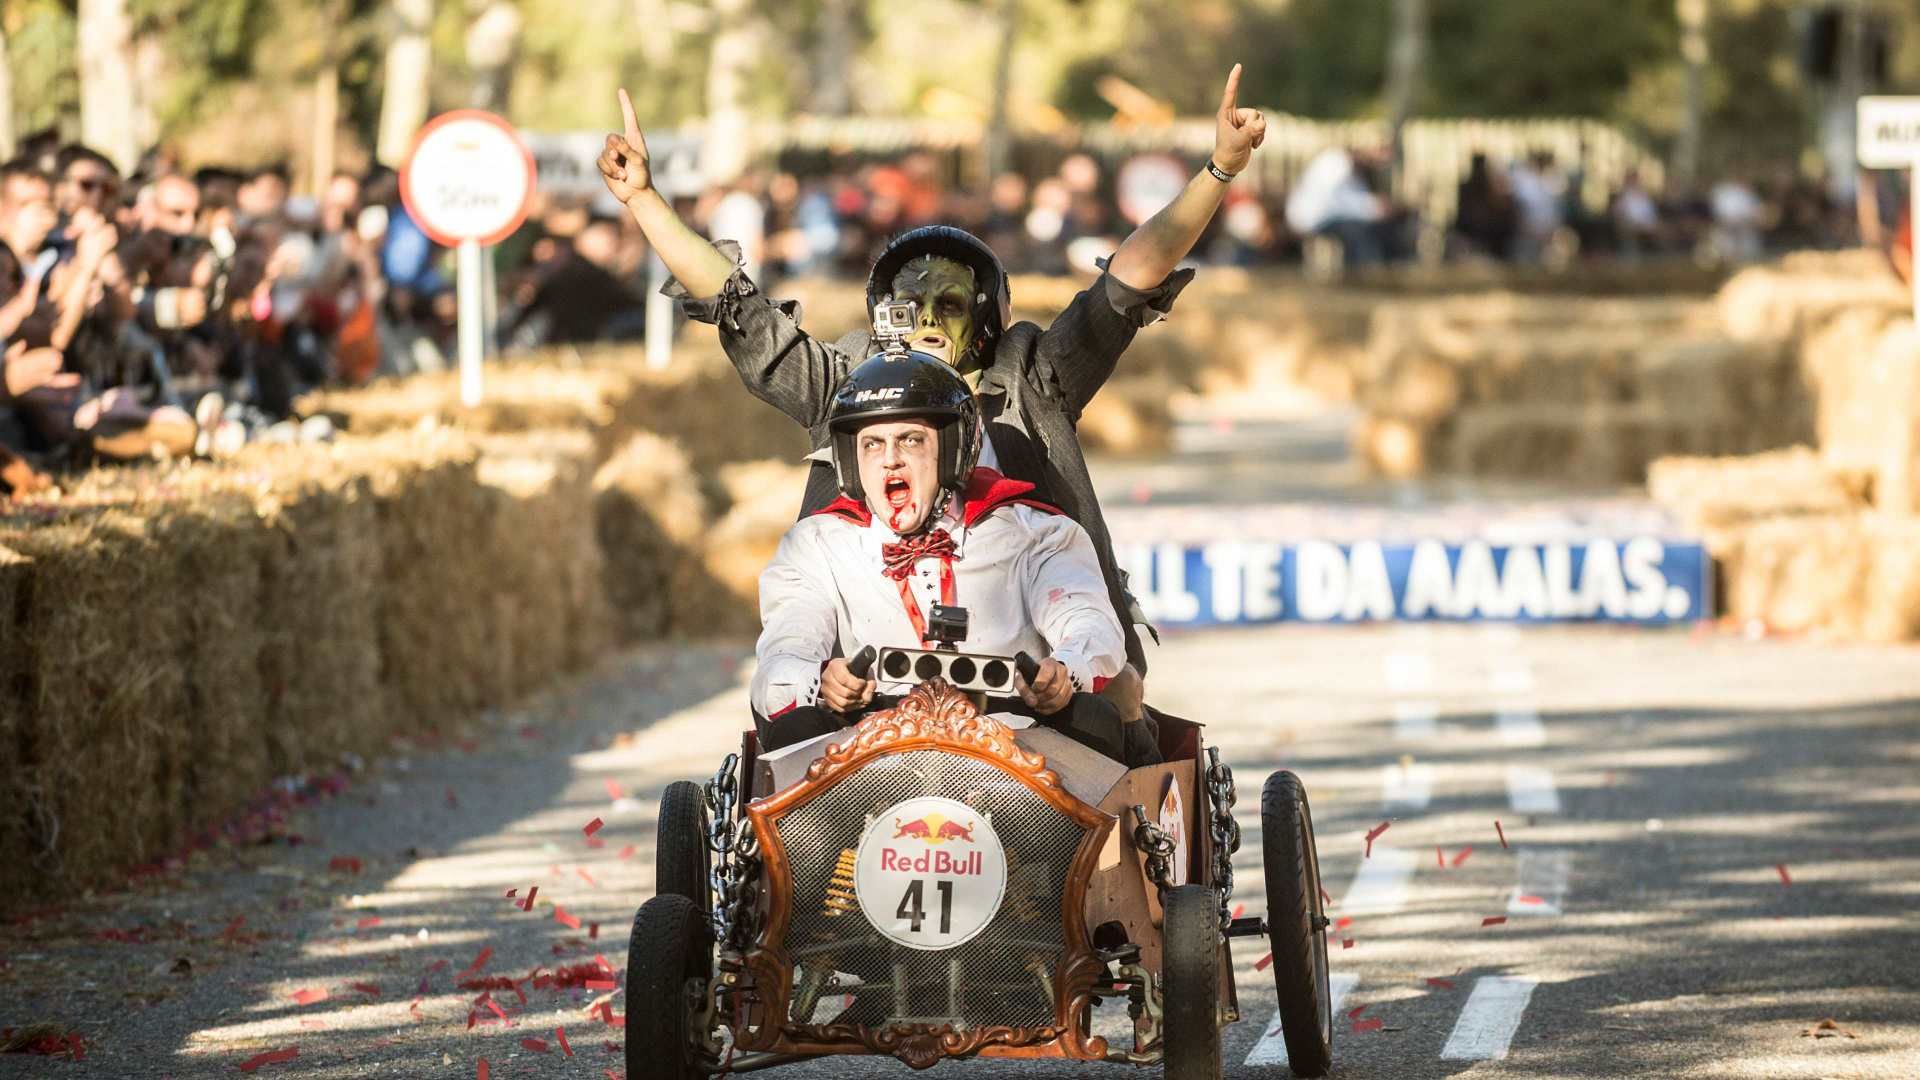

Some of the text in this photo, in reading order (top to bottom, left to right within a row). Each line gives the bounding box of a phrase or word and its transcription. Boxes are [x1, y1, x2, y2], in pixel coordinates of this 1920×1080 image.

[855, 388, 904, 403] HJC
[1118, 536, 1691, 621] LL TE DA AAALAS.
[881, 848, 982, 875] Red Bull
[896, 879, 953, 934] 41
